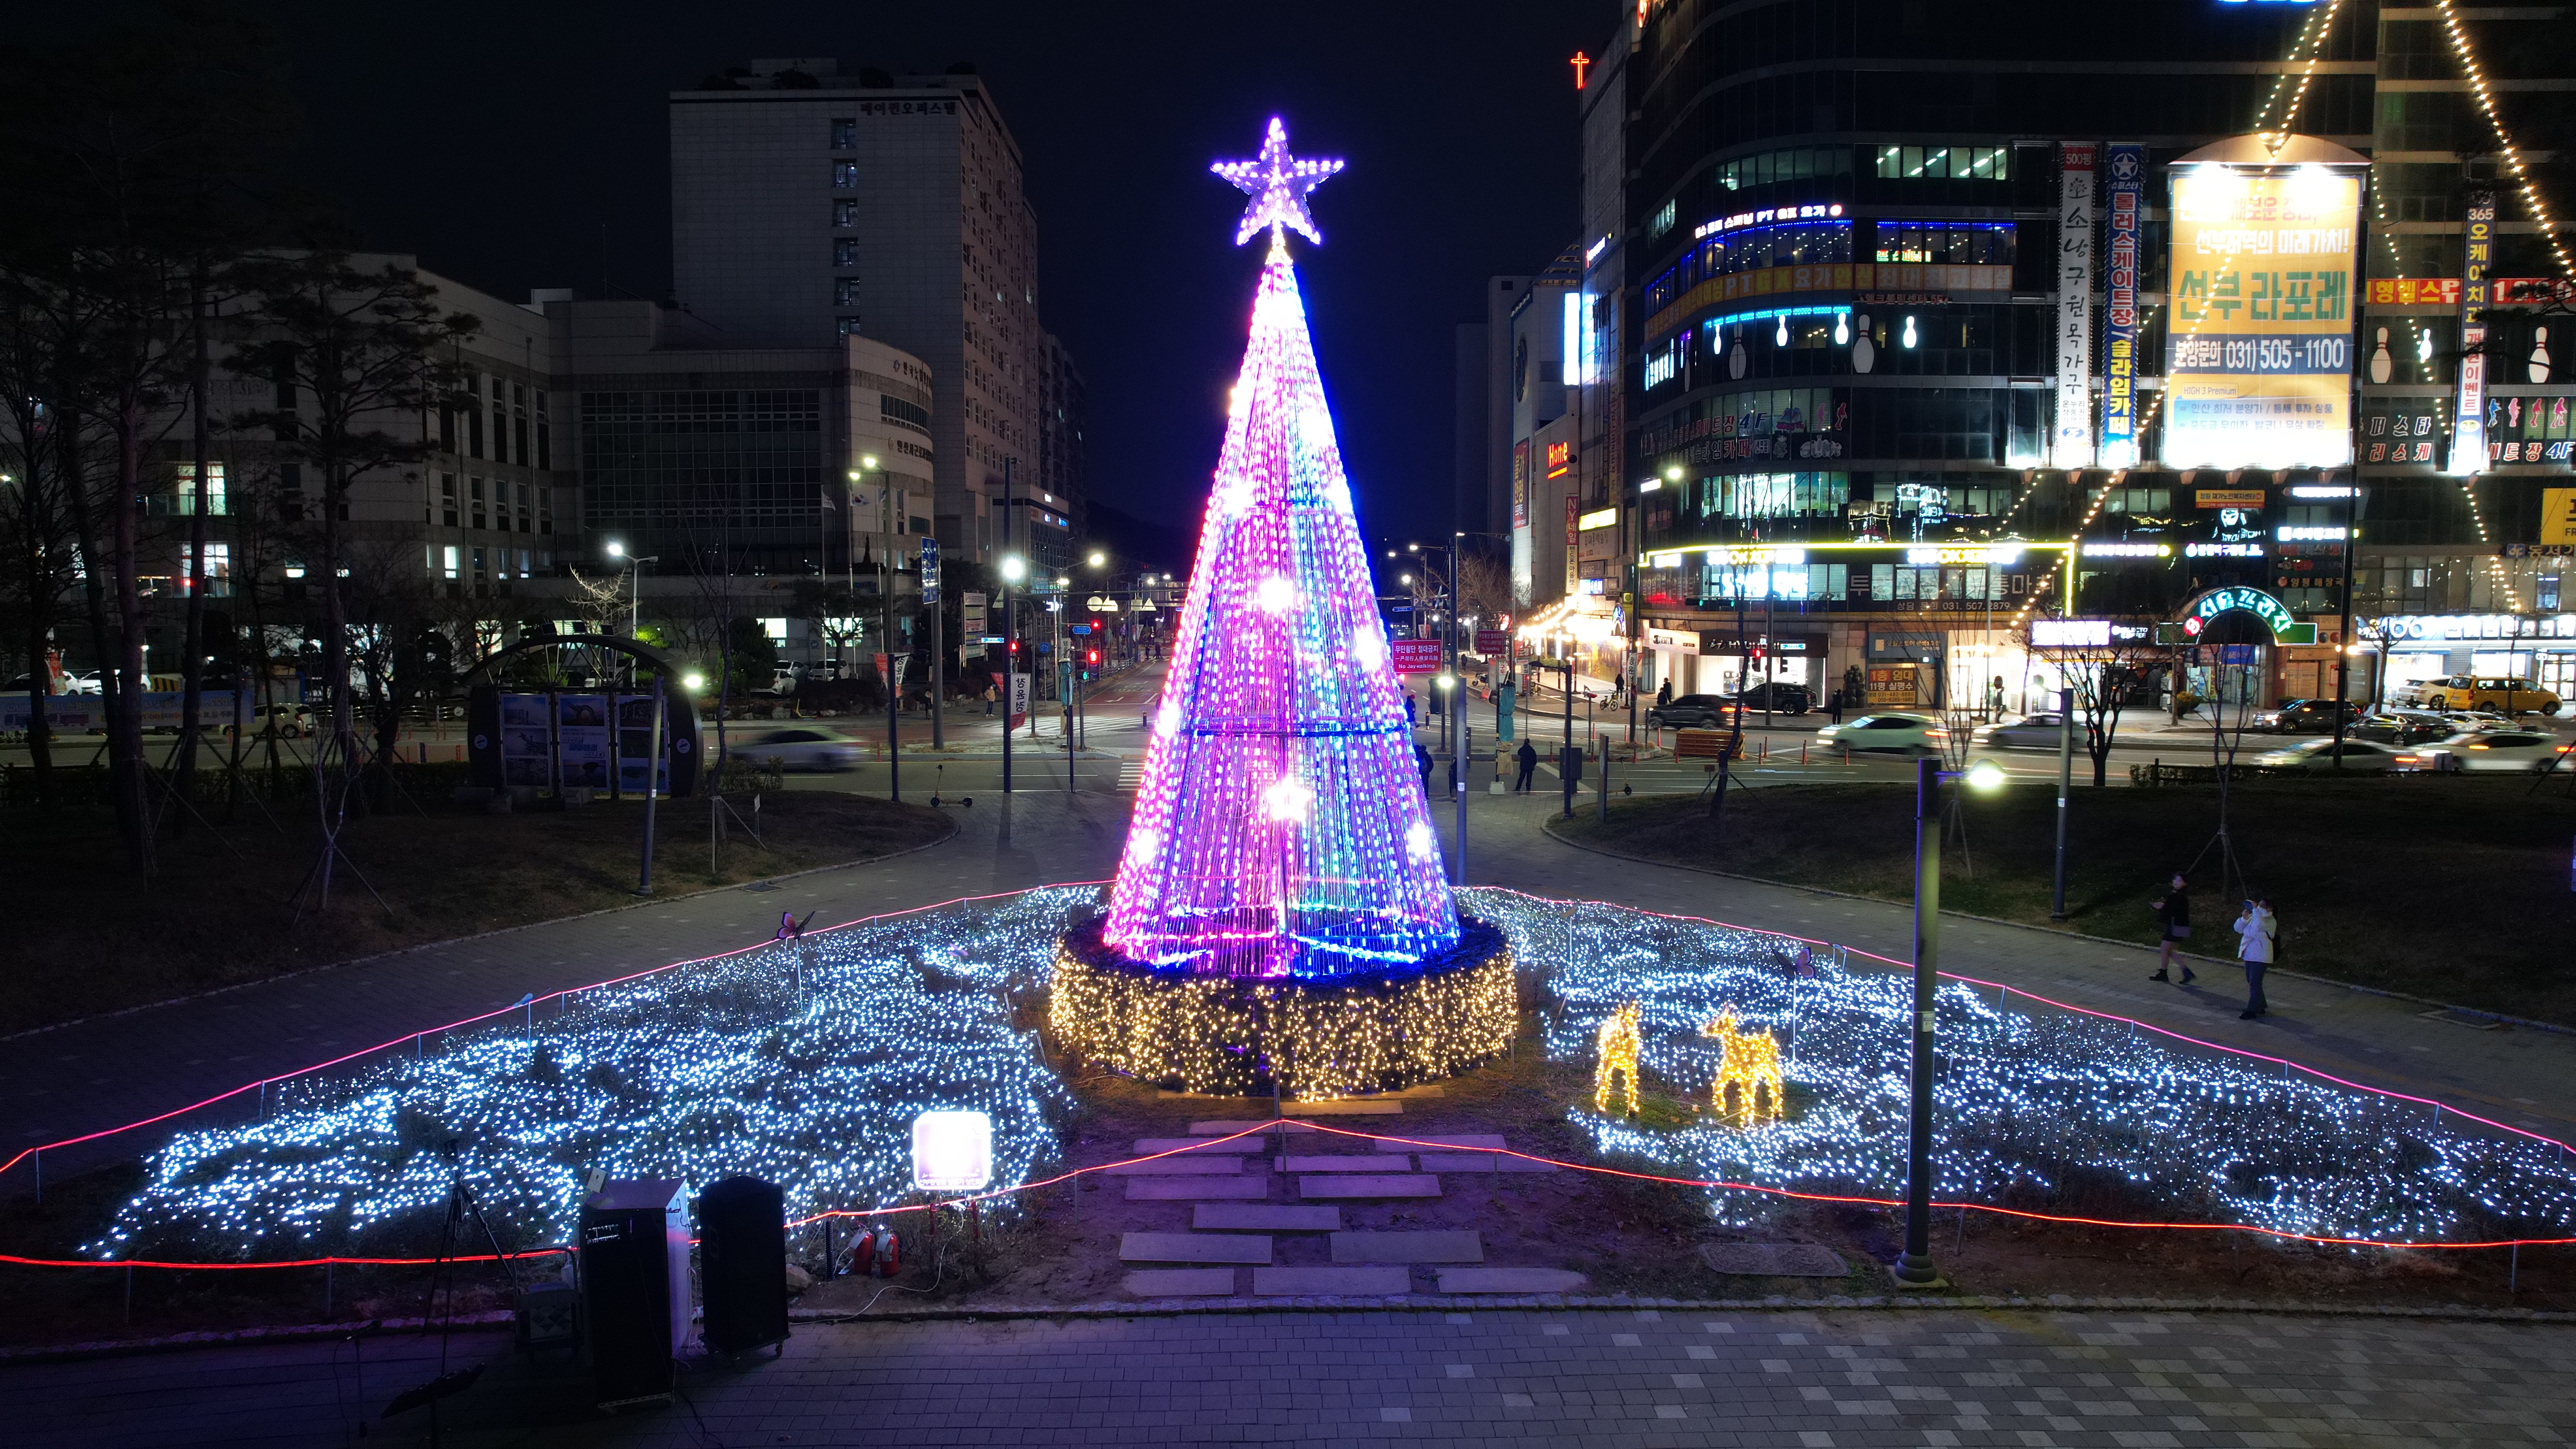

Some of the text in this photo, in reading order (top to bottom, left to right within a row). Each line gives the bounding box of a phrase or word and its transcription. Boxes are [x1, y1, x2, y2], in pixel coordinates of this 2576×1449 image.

[2066, 153, 2092, 165] 500평
[1724, 213, 1754, 229] 스피닝
[1757, 210, 1774, 223] PT
[1778, 208, 1797, 219] GX
[1801, 206, 1826, 217] 요가
[2468, 208, 2494, 220] 365
[2278, 228, 2350, 254] 미래가치!
[2109, 192, 2136, 327] 롤러스케이트장
[1726, 273, 1752, 296] PT
[1795, 266, 1831, 287] 요가
[2178, 270, 2346, 321] 선부 라포레
[2174, 340, 2221, 368] 분양문의
[2226, 339, 2256, 371] 031)
[2108, 340, 2133, 435] 슬라임카페
[2184, 386, 2236, 395] HIGH 3 Premium
[2191, 403, 2211, 414] 안산
[2214, 403, 2232, 414] 최저
[2235, 403, 2263, 414] 분양가
[2273, 403, 2292, 414] 틈새
[2295, 403, 2312, 413] 투자
[2315, 403, 2333, 414] 상품
[1739, 412, 1767, 430] 4F
[2254, 420, 2282, 430] 발코니
[2307, 419, 2325, 430] 확장
[2463, 422, 2476, 430] 2층
[1549, 442, 1568, 468] Home
[2546, 441, 2575, 459] 4F
[1897, 602, 1915, 611] 상담
[1395, 645, 1438, 653] 무단횡단 절대금지
[1871, 670, 1914, 681] 1층 임대
[1869, 682, 1914, 691] 11평 실평수
